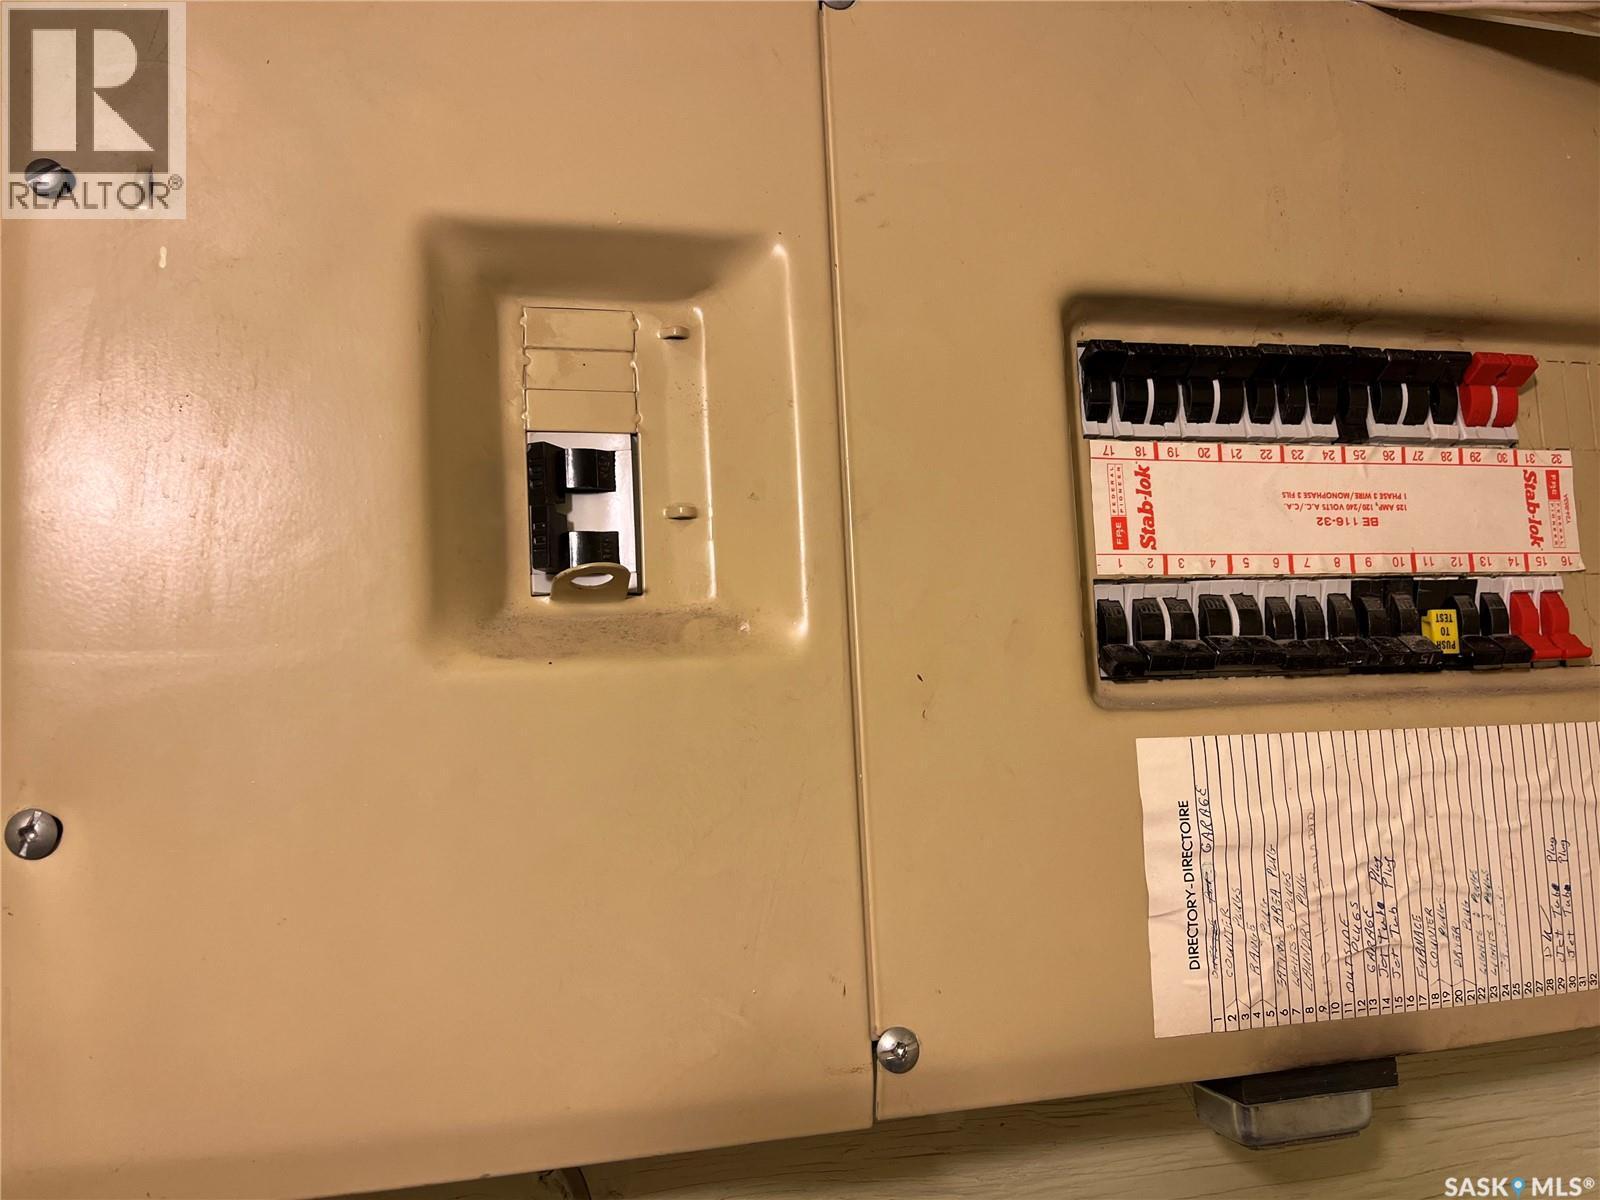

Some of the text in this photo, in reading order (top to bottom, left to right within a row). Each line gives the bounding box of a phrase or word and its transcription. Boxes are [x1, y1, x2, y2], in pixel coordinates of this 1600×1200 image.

[1103, 445, 1562, 464] 32 31 30 29 28 27 26 25 24 23 22 21 20 19 18 17
[1303, 492, 1372, 500] WIRE/MONOPHASE
[1379, 492, 1402, 500] PHASE
[1134, 464, 1157, 550] Stab-lok
[1346, 504, 1374, 512] 120/240
[1523, 470, 1544, 548] Stab-lok
[1316, 517, 1379, 526] BE 116-32
[1118, 556, 1573, 569] 16 15 14 13 12 11 10 9 8 7 6 5 4 3 2 1
[1436, 613, 1453, 622] TEST
[1440, 626, 1450, 636] TO
[1194, 784, 1214, 854] GARAGE
[1266, 844, 1279, 878] PLUG
[1177, 800, 1201, 970] DIRECTORY-DIRECTOIRE
[1269, 888, 1284, 928] AREA
[1349, 901, 1362, 952] PLUGS
[1362, 906, 1376, 973] GARAGE
[1536, 980, 1543, 992] 27
[1546, 978, 1554, 991] 28
[1558, 977, 1565, 990] 29
[1569, 976, 1576, 988] 30
[1579, 976, 1586, 987] 31
[1590, 974, 1597, 986] 32
[1478, 987, 1486, 1000] 22
[1490, 986, 1498, 998] 23
[1502, 984, 1510, 997] 24
[1513, 983, 1520, 995] 25
[1524, 981, 1532, 994] 26
[1419, 994, 1427, 1006] 17
[1431, 993, 1439, 1005] 18
[1443, 991, 1450, 1003] 19
[1455, 990, 1463, 1002] 20
[1467, 990, 1475, 1000] 21
[1357, 1000, 1366, 1012] 12
[1369, 998, 1377, 1010] 13
[1382, 998, 1390, 1010] 14
[1394, 996, 1402, 1008] 15
[1406, 995, 1414, 1008] 16
[1305, 1006, 1314, 1014] 8
[1331, 1002, 1340, 1014] 10
[1344, 1003, 1352, 1013] 11
[1228, 1014, 1236, 1022] 2
